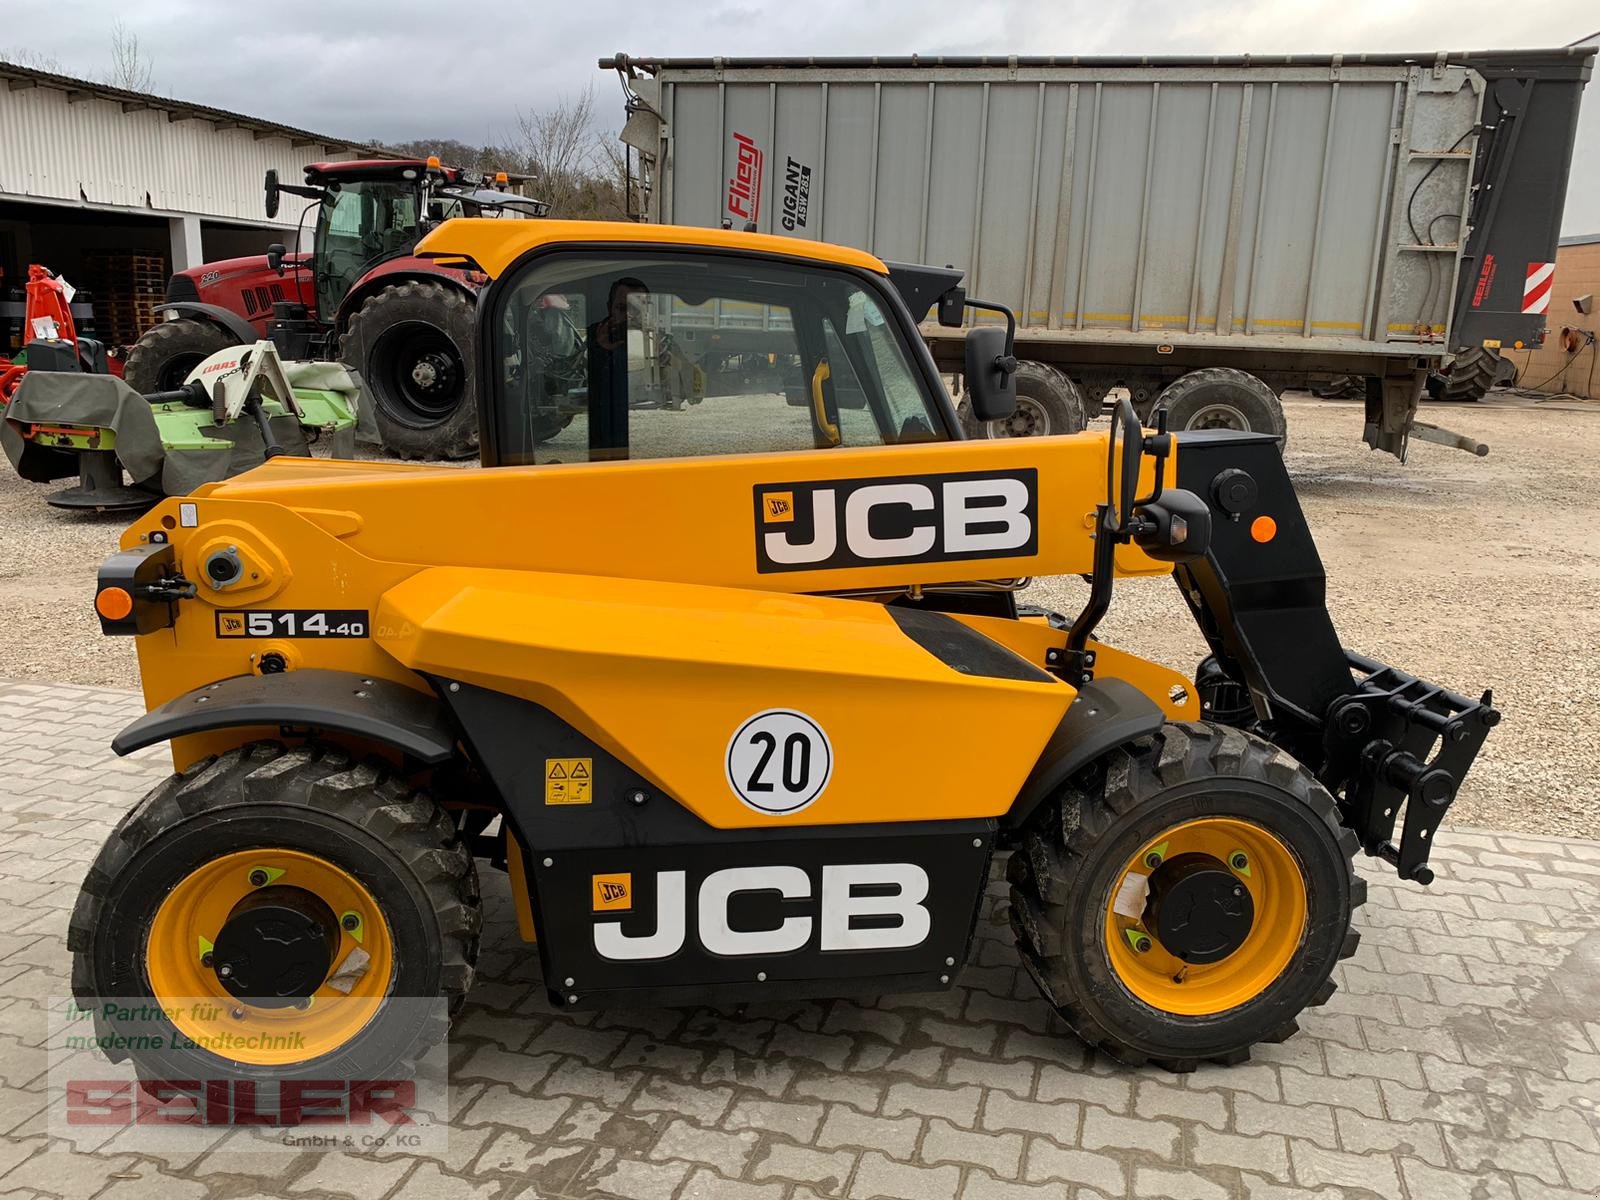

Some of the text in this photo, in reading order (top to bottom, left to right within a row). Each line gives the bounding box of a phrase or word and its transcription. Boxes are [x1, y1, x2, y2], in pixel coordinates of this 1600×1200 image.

[728, 132, 760, 218] Fliegl
[782, 156, 801, 231] GIGANT
[798, 174, 810, 220] ASW 281
[200, 271, 219, 282] 220
[1472, 255, 1494, 306] SEILER
[203, 361, 237, 374] CLAAS
[765, 478, 1031, 564] JCB
[771, 500, 788, 514] JCB
[248, 613, 363, 636] 514-40
[747, 731, 811, 793] 20
[594, 863, 931, 960] JCB
[603, 884, 625, 900] JCB
